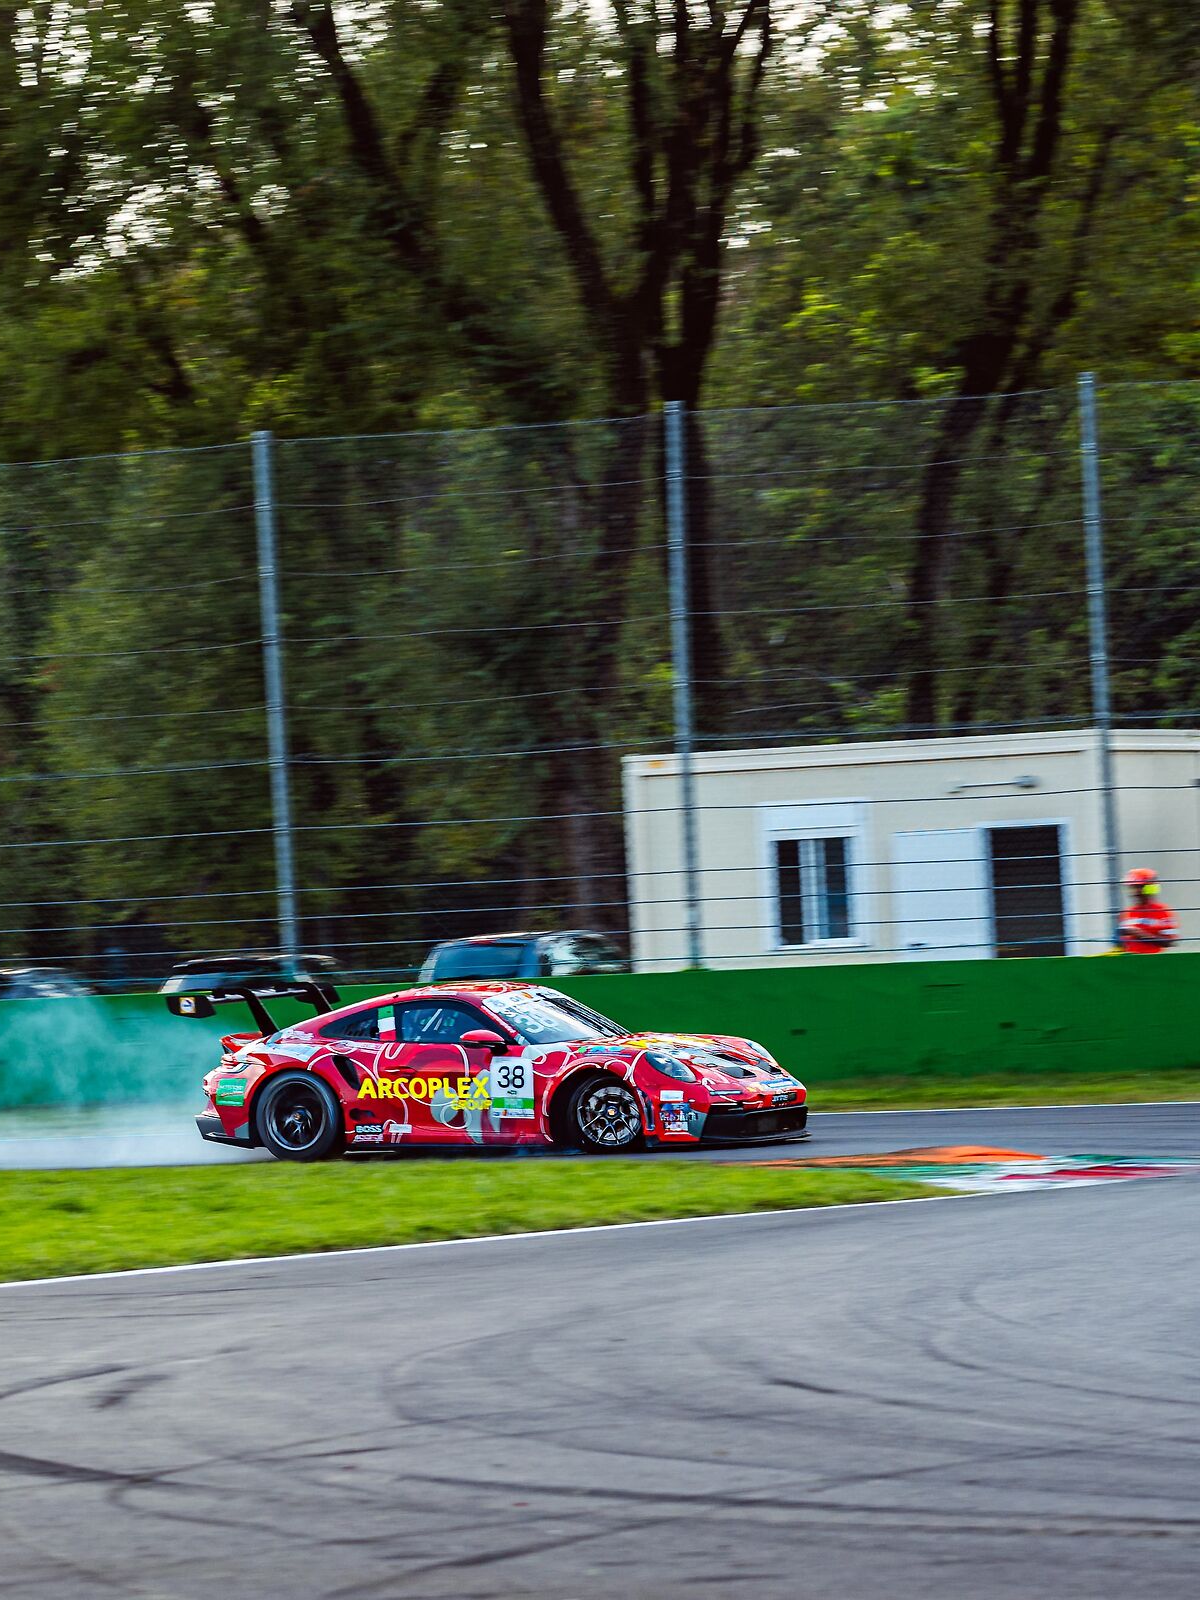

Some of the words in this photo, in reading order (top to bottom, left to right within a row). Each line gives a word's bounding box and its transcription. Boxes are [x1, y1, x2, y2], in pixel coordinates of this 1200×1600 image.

[357, 1077, 490, 1099] ARCOPLEX
[497, 1065, 525, 1089] 38
[355, 1125, 383, 1133] BOSS
